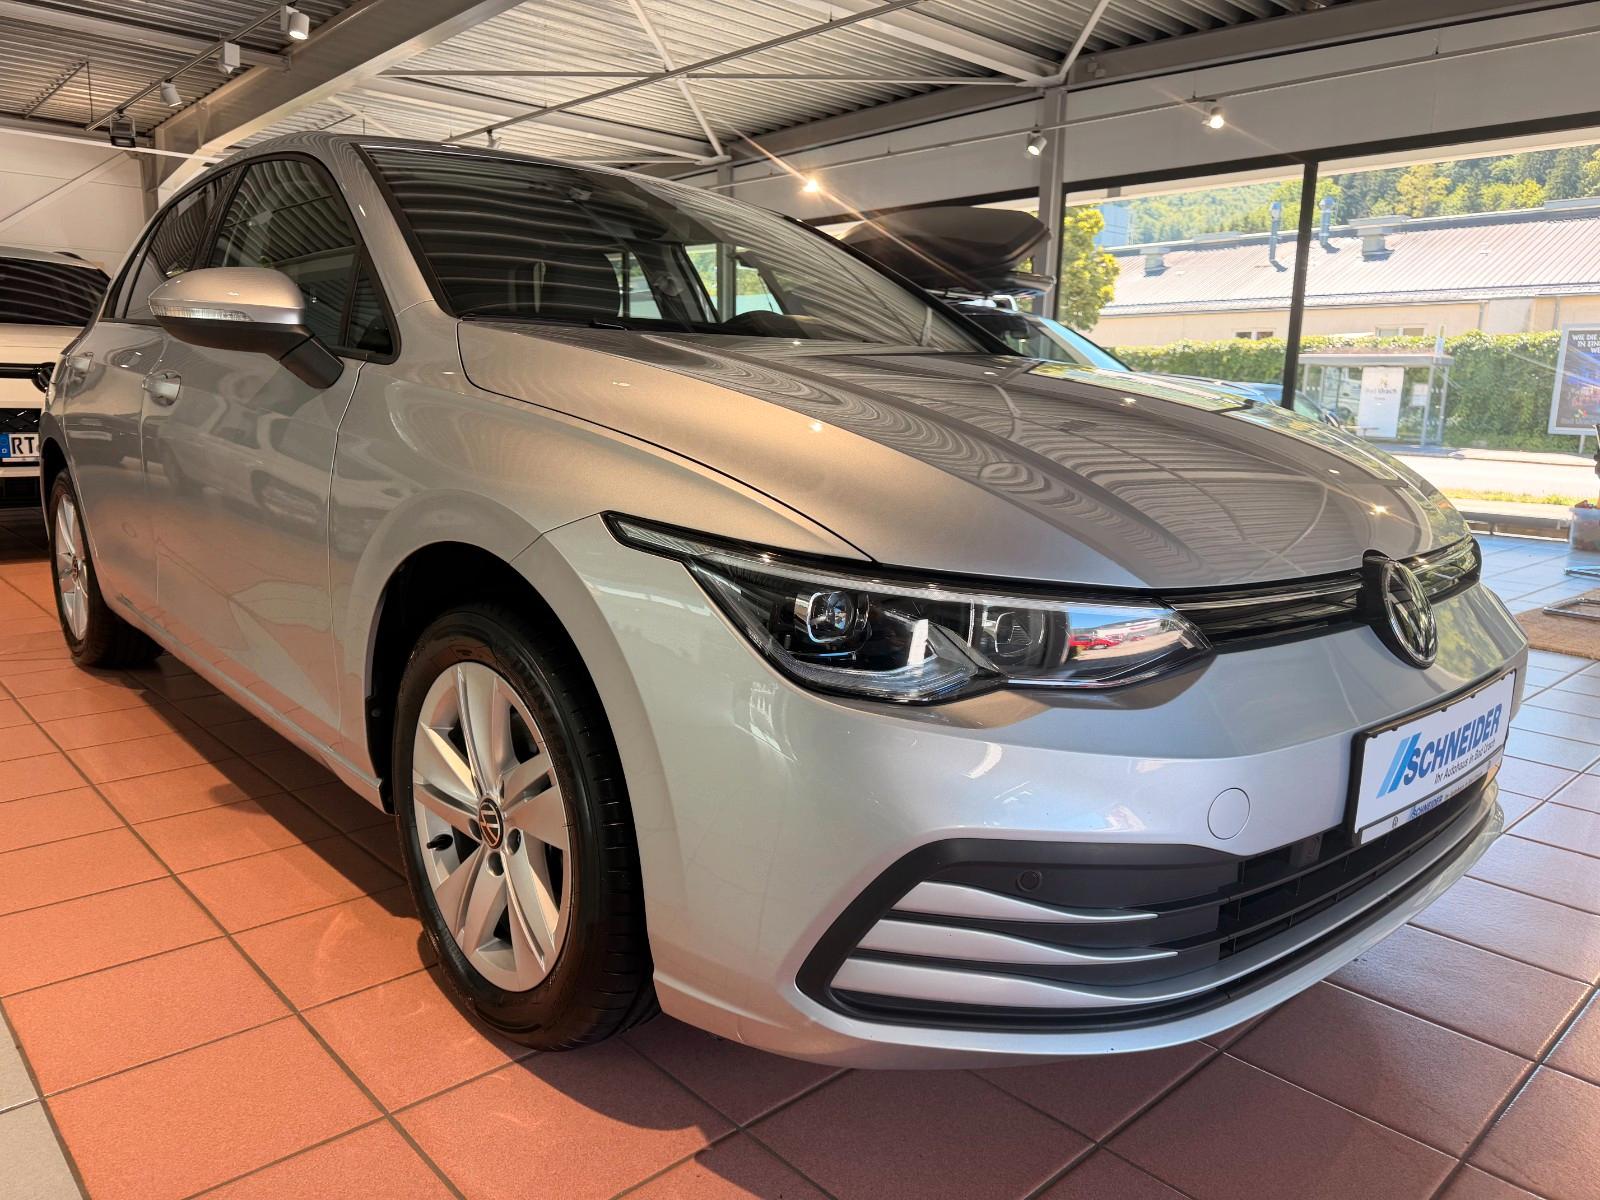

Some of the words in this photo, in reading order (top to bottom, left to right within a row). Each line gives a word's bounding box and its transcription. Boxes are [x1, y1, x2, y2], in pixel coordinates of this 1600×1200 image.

[11, 437, 34, 454] RT
[1403, 703, 1502, 786] SCHNEIDER
[1443, 757, 1469, 779] Autohaus
[1474, 747, 1483, 760] Bad
